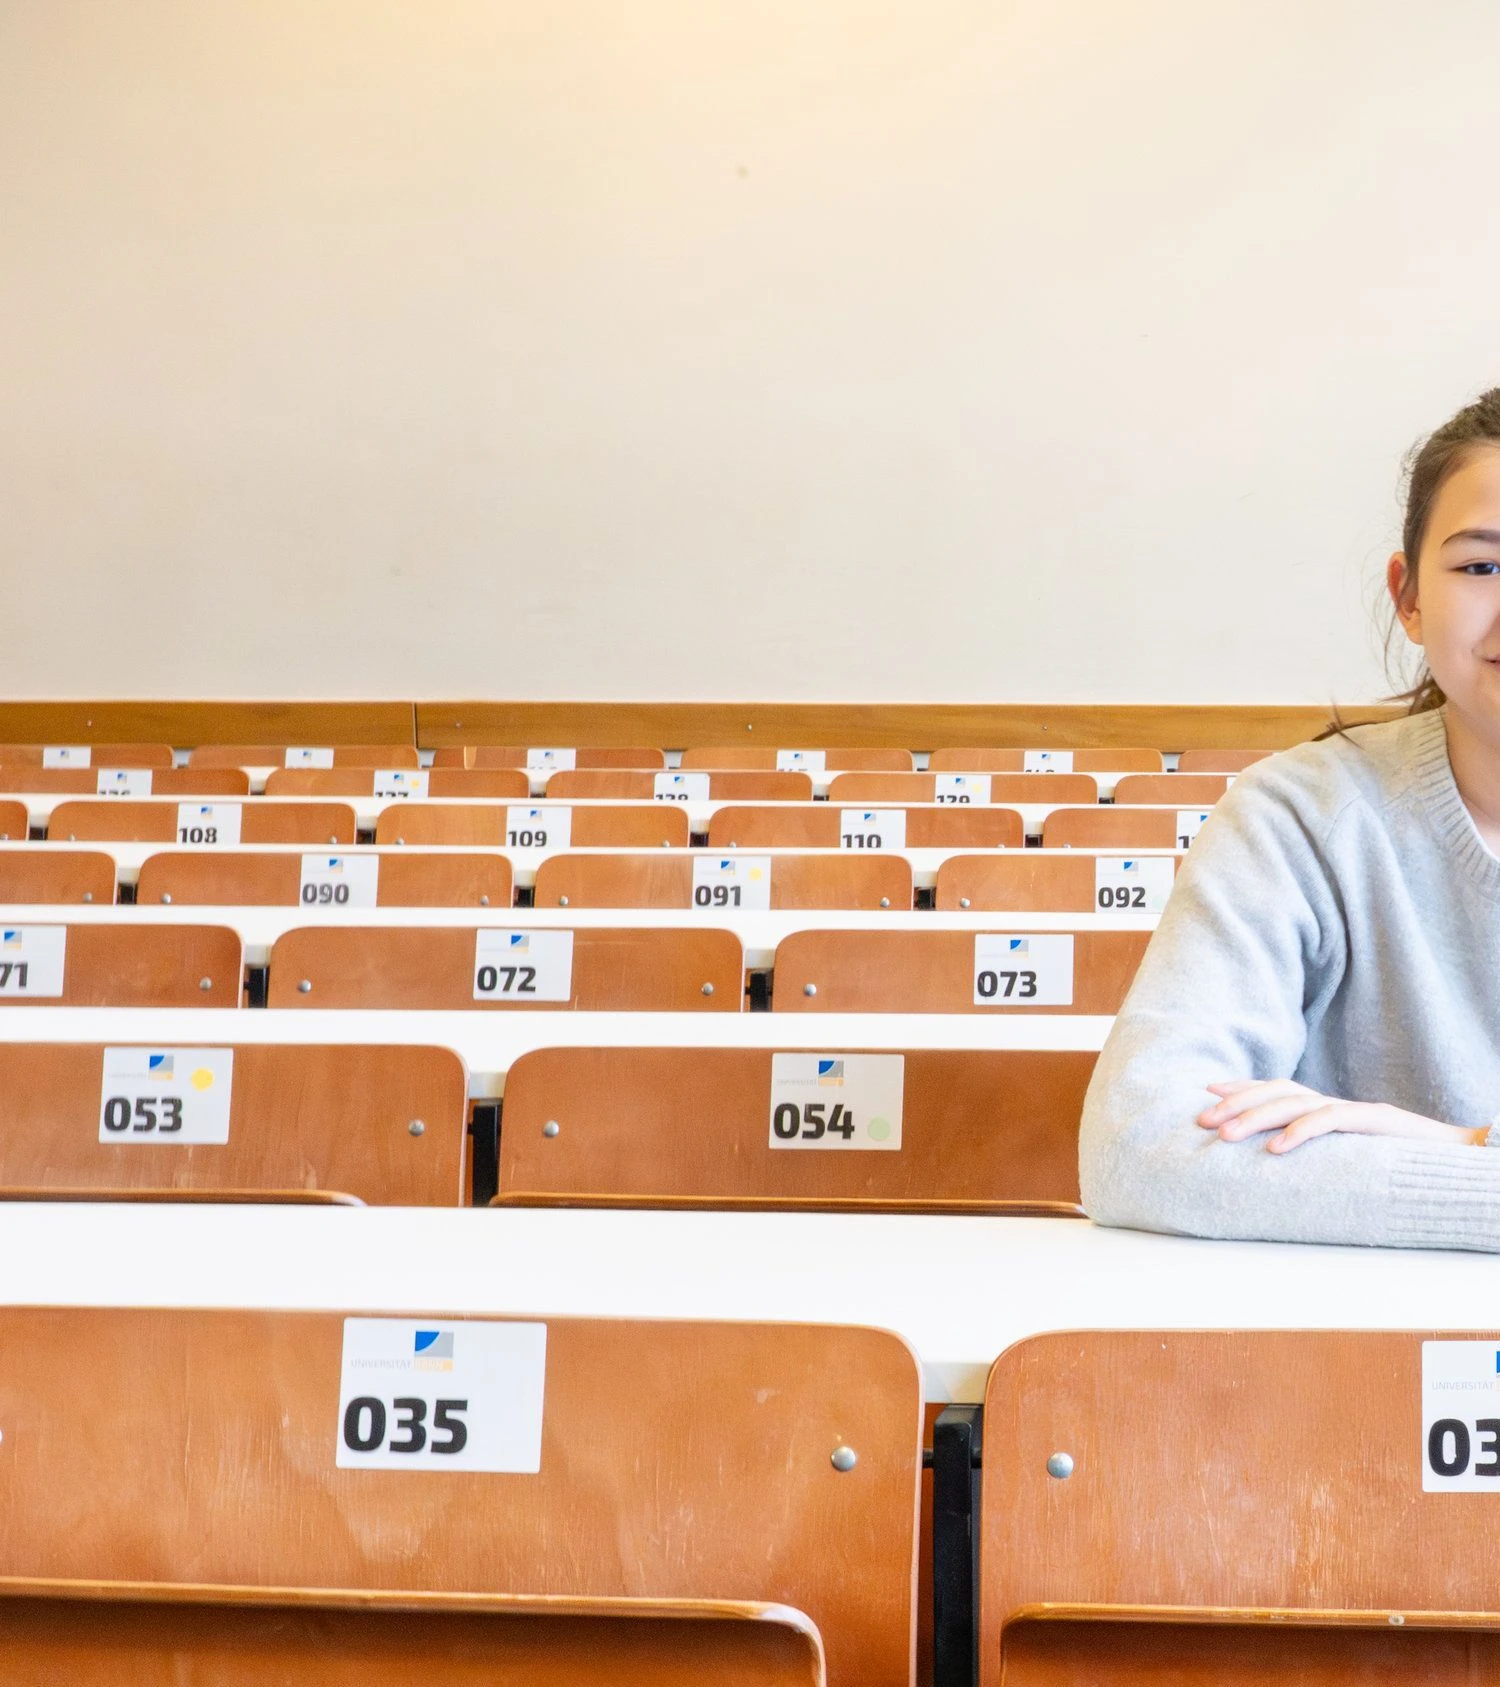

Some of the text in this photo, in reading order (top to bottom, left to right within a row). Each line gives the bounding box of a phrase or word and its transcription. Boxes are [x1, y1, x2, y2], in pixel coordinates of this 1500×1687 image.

[180, 828, 218, 844] 108
[508, 830, 548, 847] 109
[842, 834, 882, 848] 110
[302, 883, 349, 905] 090
[694, 885, 740, 907] 091
[1098, 886, 1146, 909] 092
[476, 965, 537, 993] 072
[976, 970, 1038, 998] 073
[103, 1096, 183, 1133] 053
[773, 1102, 856, 1140] 054
[343, 1396, 469, 1455] 035
